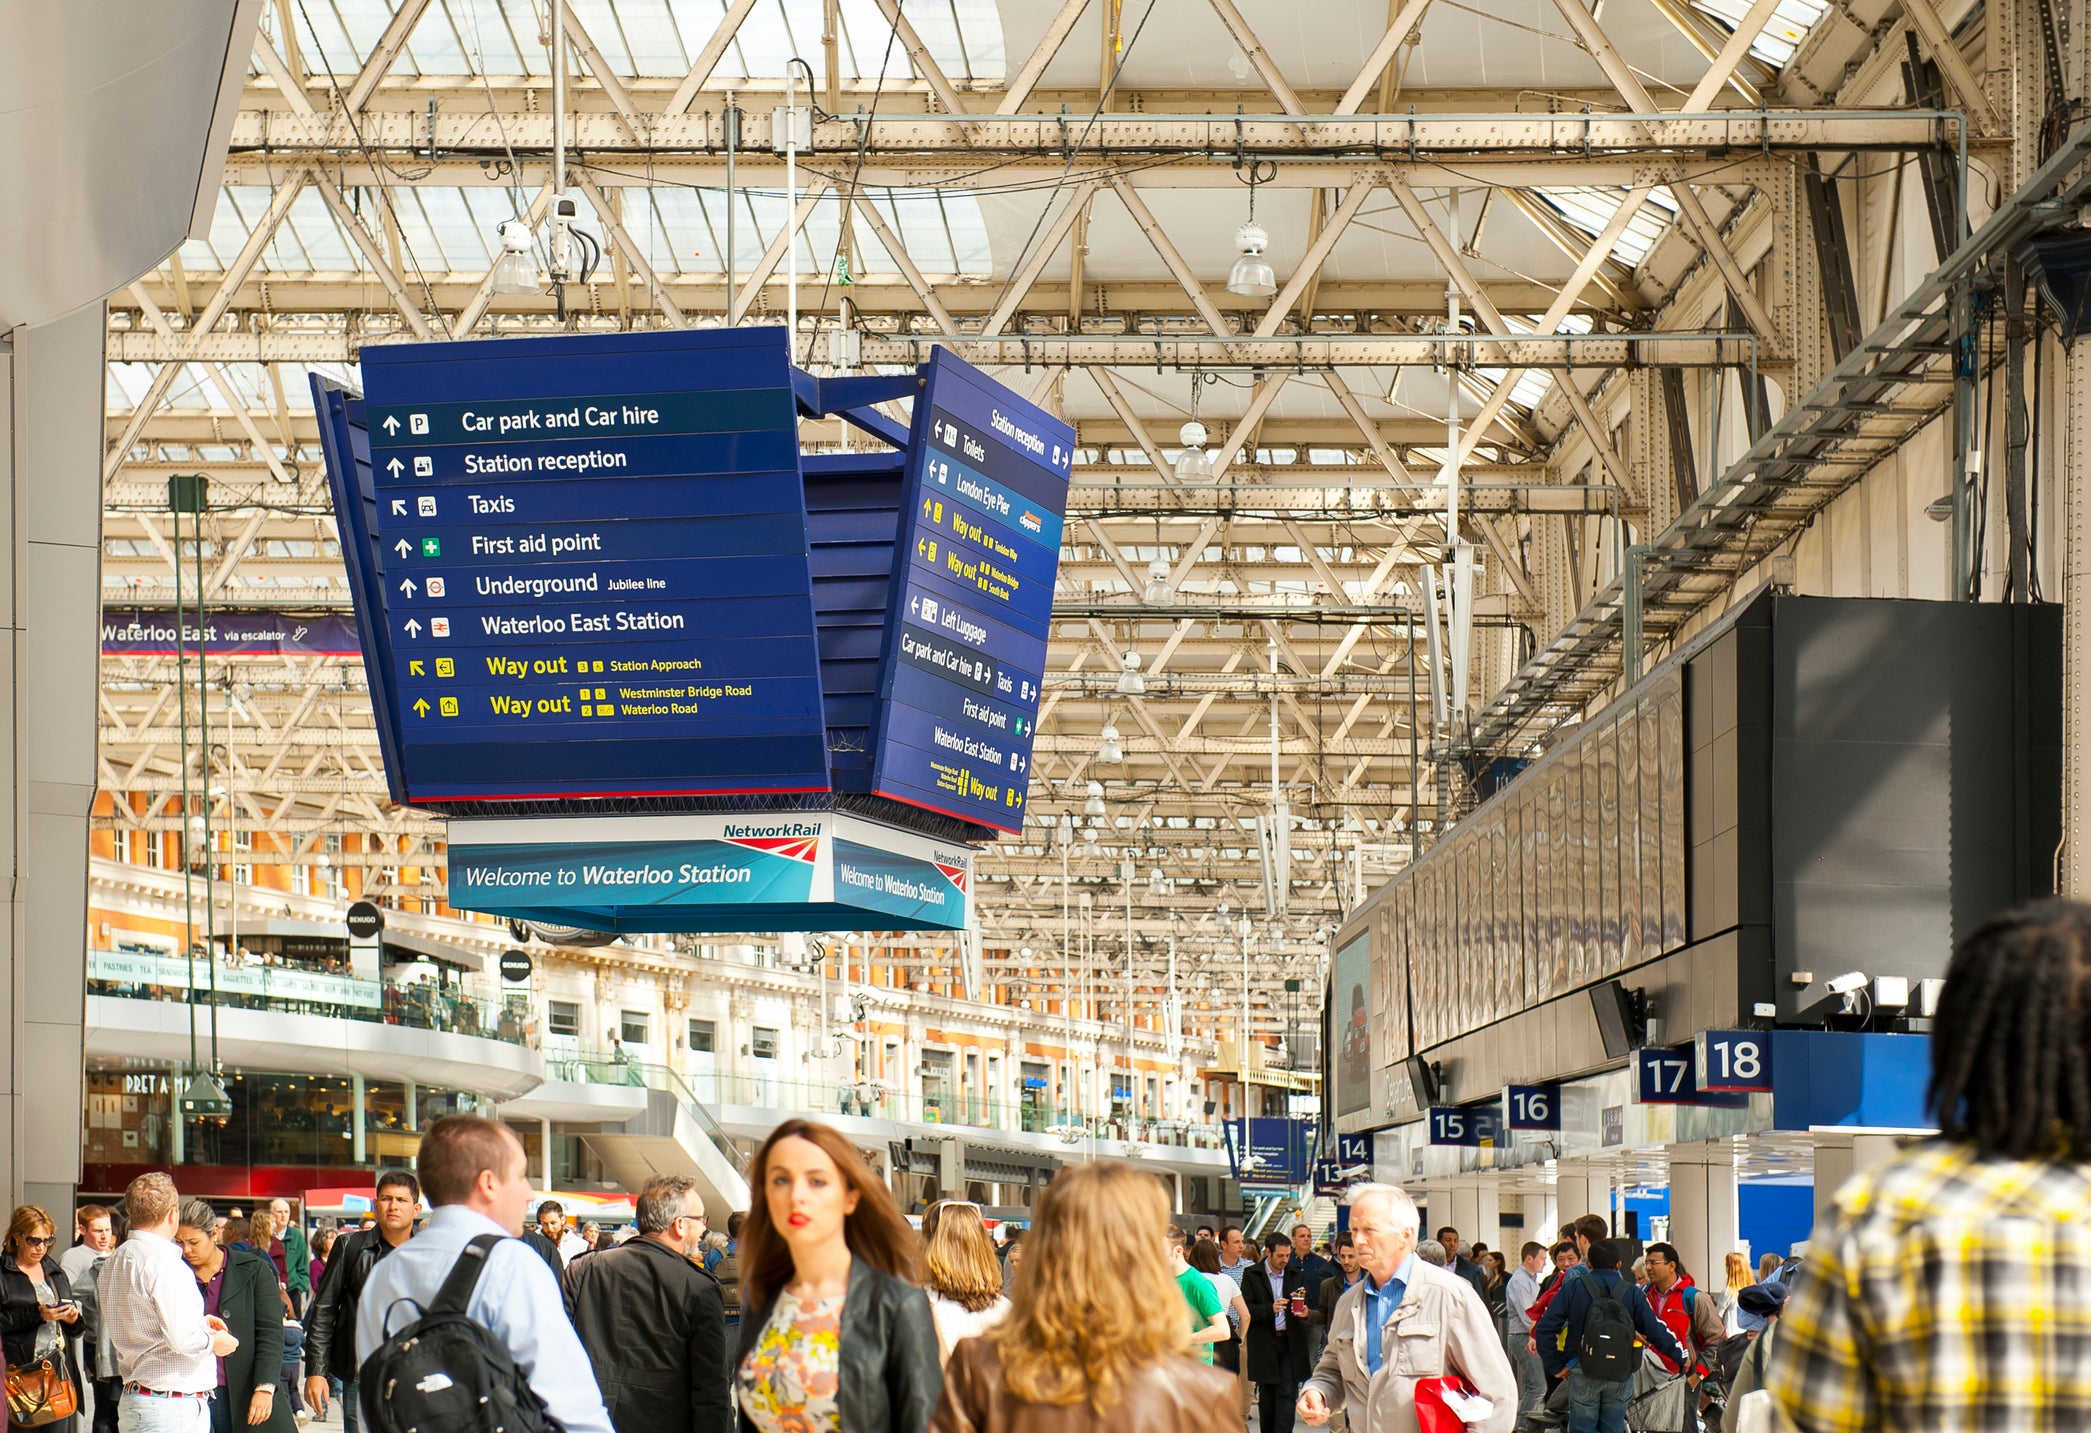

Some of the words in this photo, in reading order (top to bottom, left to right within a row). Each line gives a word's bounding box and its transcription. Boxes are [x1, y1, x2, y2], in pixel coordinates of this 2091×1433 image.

[461, 411, 494, 432] Car
[499, 410, 540, 435] park
[545, 408, 580, 428] and
[584, 406, 618, 427] Car
[621, 405, 660, 425] hire
[991, 408, 1016, 439] Station
[1015, 426, 1045, 457] reception
[963, 435, 985, 464] Toilets
[464, 453, 533, 475] Station
[537, 450, 627, 477] reception
[467, 494, 516, 514] Taxis
[956, 472, 984, 502] London
[983, 484, 997, 511] Eye
[996, 491, 1011, 517] Pier
[953, 512, 969, 541] Way
[968, 521, 983, 544] out
[471, 535, 515, 555] First
[518, 533, 546, 553] aid
[551, 532, 602, 556] point
[947, 550, 963, 579] Way
[963, 560, 977, 583] out
[475, 572, 598, 598] Underground
[607, 578, 645, 591] Jubilee
[646, 577, 667, 590] line
[101, 623, 177, 642] Waterloo
[182, 625, 217, 642] East
[224, 630, 240, 642] via
[241, 630, 286, 642] escalator
[480, 615, 566, 636] Waterloo
[570, 613, 611, 633] East
[615, 611, 685, 631] Station
[941, 607, 957, 631] Left
[956, 616, 987, 645] Luggage
[486, 657, 529, 680] Way
[533, 656, 569, 675] out
[610, 659, 649, 672] Station
[650, 657, 702, 674] Approach
[902, 632, 916, 655] Car
[914, 641, 932, 662] park
[932, 645, 946, 667] and
[945, 652, 960, 672] Car
[958, 656, 973, 678] hire
[619, 687, 686, 700] Westminster
[687, 686, 723, 700] Bridge
[724, 684, 753, 697] Road
[997, 670, 1013, 695] Taxis
[490, 696, 534, 719] Way
[537, 695, 572, 714] out
[620, 704, 669, 716] Waterloo
[671, 702, 699, 715] Road
[962, 697, 979, 718] First
[978, 705, 989, 723] aid
[988, 709, 1007, 730] point
[934, 726, 964, 753] Waterloo
[963, 736, 979, 757] East
[978, 742, 1002, 766] Station
[970, 776, 987, 802] Way
[985, 785, 999, 802] out
[723, 822, 822, 839] NetworkRail
[933, 850, 968, 869] NetworkRail
[466, 865, 552, 889] Welcome
[556, 868, 577, 887] to
[581, 863, 674, 887] Waterloo
[677, 863, 752, 885] Station
[841, 863, 875, 891] Welcome
[875, 874, 884, 892] to
[884, 873, 918, 900] Waterloo
[918, 883, 946, 907] Station
[349, 915, 377, 924] BENUGO
[103, 961, 133, 973] PASTRIES
[140, 964, 153, 974] TEA
[222, 973, 254, 985] BAGUETTES
[502, 961, 530, 970] BENUGO
[1713, 1041, 1761, 1079] 18
[125, 1074, 156, 1094] PRET
[159, 1075, 169, 1095] A
[1647, 1059, 1688, 1094] 17
[1513, 1093, 1550, 1121] 16
[1342, 1139, 1368, 1160] 14
[1321, 1163, 1344, 1183] 13
